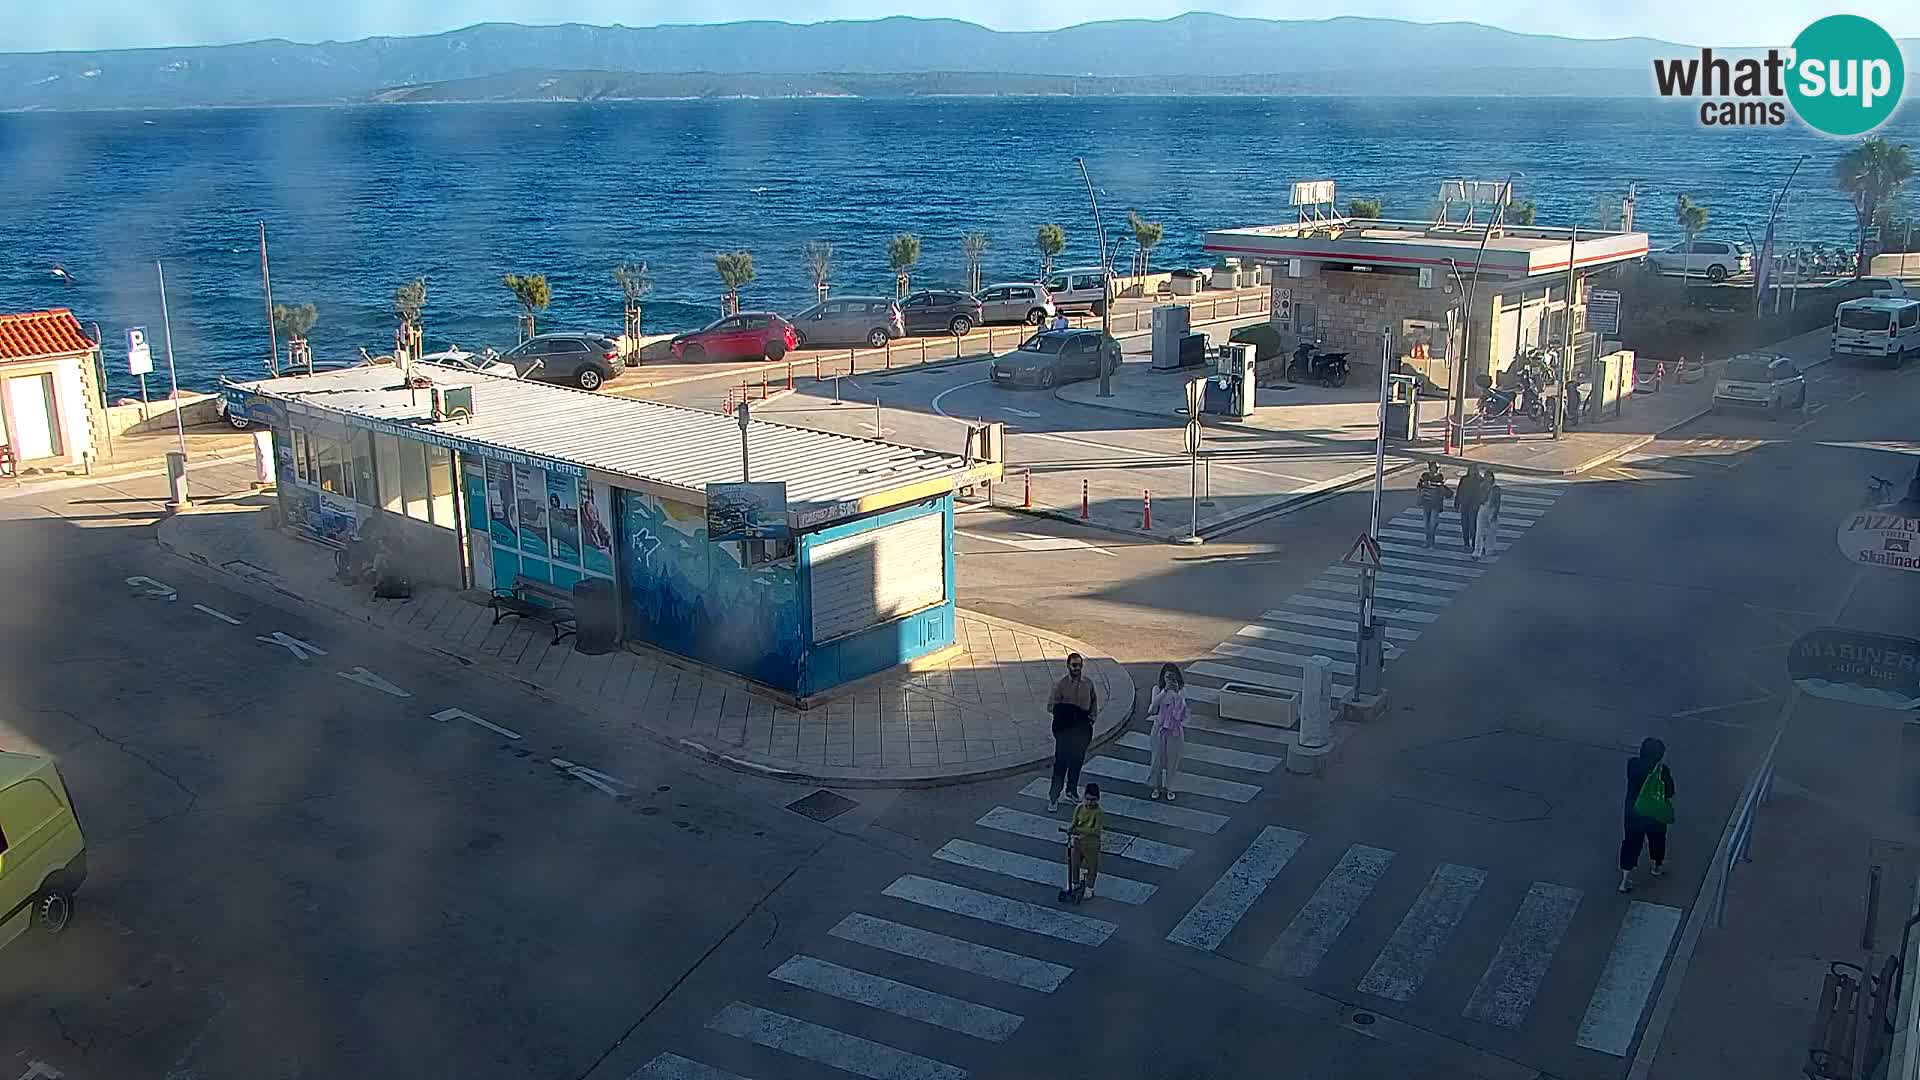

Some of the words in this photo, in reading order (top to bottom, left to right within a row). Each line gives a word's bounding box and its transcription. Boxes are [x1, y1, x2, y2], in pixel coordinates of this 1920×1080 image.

[437, 437, 469, 452] POSTAJA
[479, 447, 494, 458] BUS
[495, 452, 527, 465] STATION
[530, 457, 554, 471] TICKET
[556, 463, 583, 477] OFFICE
[1848, 513, 1920, 533] PIZZE
